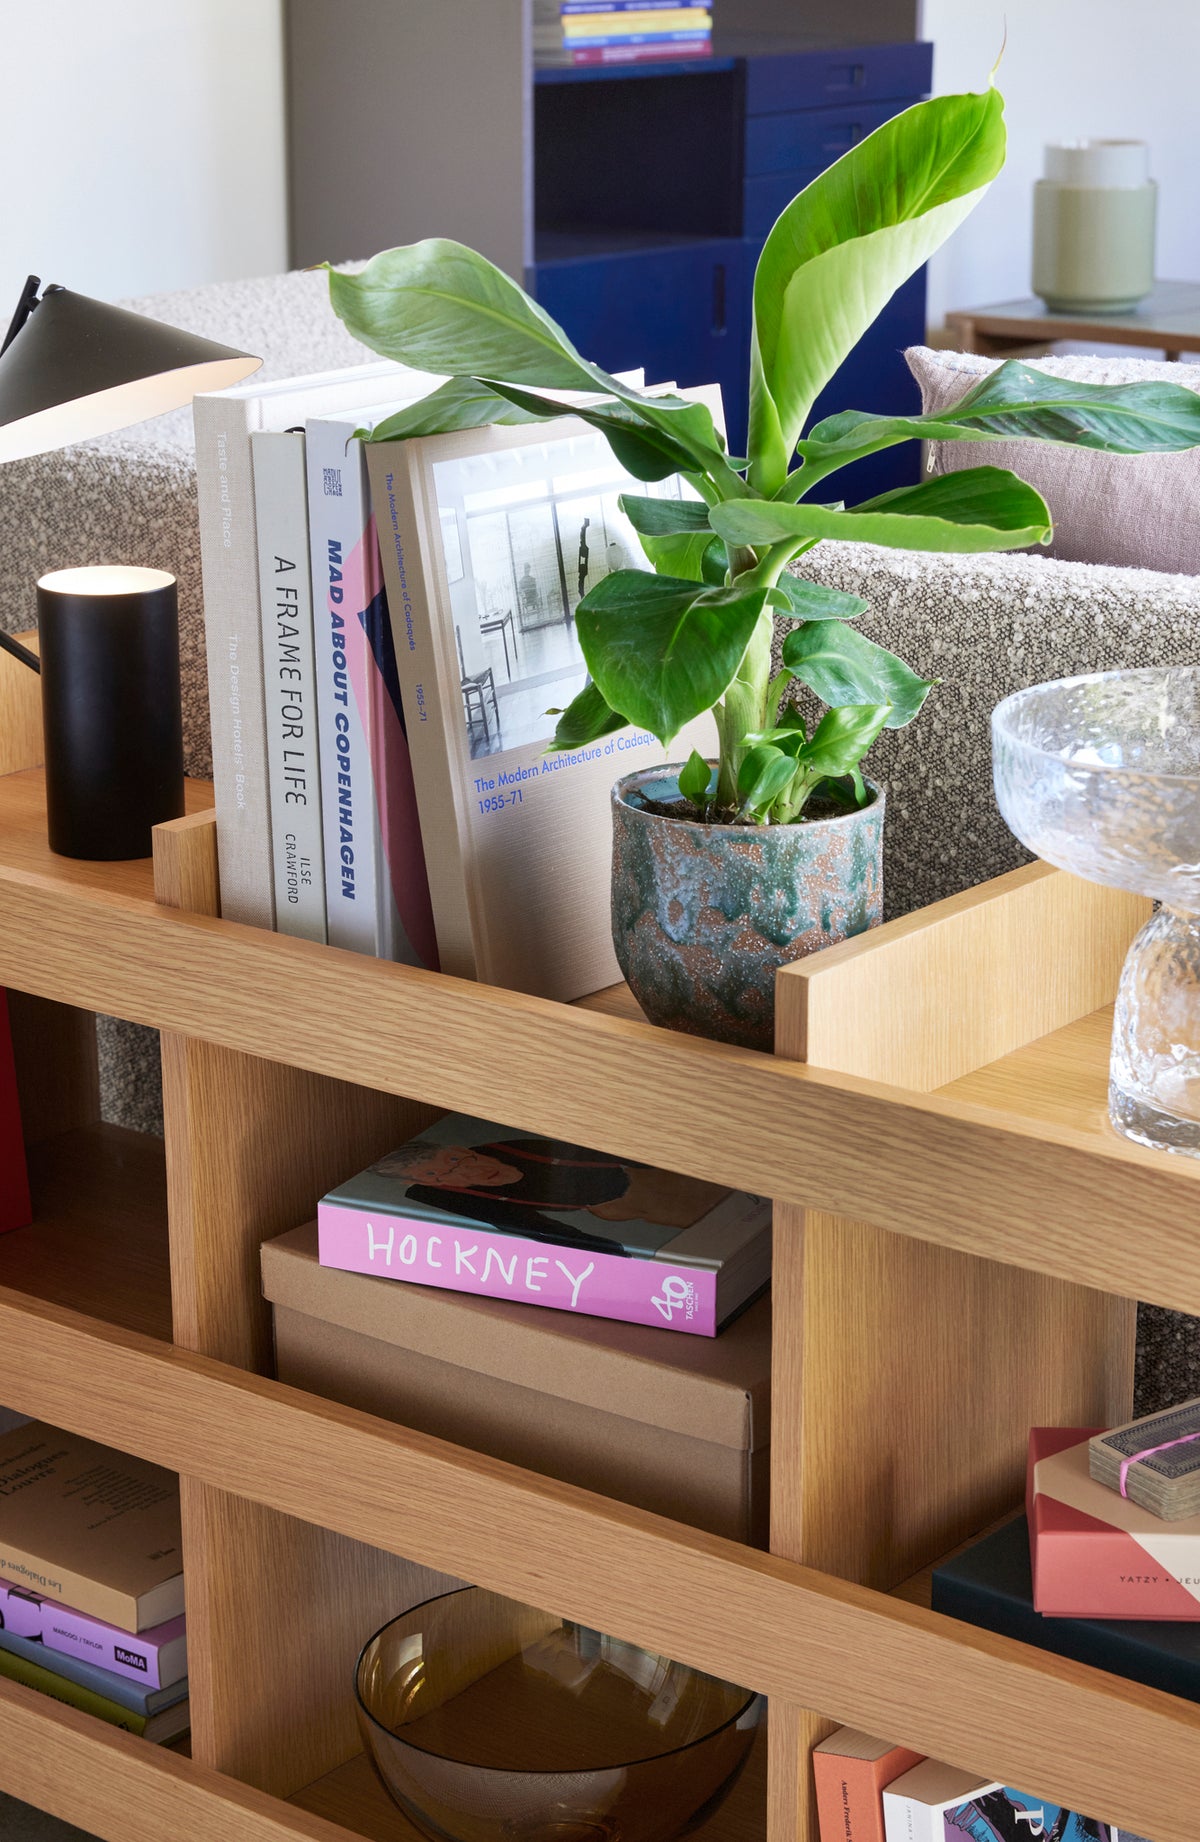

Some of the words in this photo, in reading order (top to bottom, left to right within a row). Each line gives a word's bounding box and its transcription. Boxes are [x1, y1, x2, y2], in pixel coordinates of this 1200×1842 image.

[218, 431, 228, 471] Taste
[220, 475, 232, 503] and
[385, 473, 393, 491] The
[222, 507, 232, 548] Place
[388, 493, 399, 530] Modern
[274, 556, 296, 573] A
[328, 539, 343, 604] MAD
[393, 533, 407, 589] Architecture
[402, 591, 411, 601] of
[228, 634, 238, 660] The
[276, 587, 301, 681] FRAME
[404, 604, 416, 651] Cadaqués
[331, 611, 348, 706] ABOUT
[229, 666, 240, 715] Design
[280, 689, 304, 739] FOR
[283, 750, 307, 806] LIFE
[474, 779, 495, 793] The
[498, 766, 539, 788] Modern
[542, 747, 602, 772] Architecture
[604, 739, 615, 755] of
[617, 732, 656, 750] Cadaqu
[234, 773, 246, 809] Book
[335, 712, 355, 900] COPENHAGEN
[285, 833, 299, 904] CRAWFORD
[300, 857, 311, 886] ILSE
[366, 1222, 594, 1307] HOCKNEY
[650, 1275, 689, 1321] 40
[686, 1281, 694, 1321] TASCHEN
[7, 1562, 49, 1588] Dialogues
[48, 1582, 63, 1593] Les
[83, 1639, 104, 1650] TAYLOR
[116, 1649, 145, 1669] MoMA
[841, 1780, 849, 1805] Anders
[844, 1806, 852, 1837] Frederik
